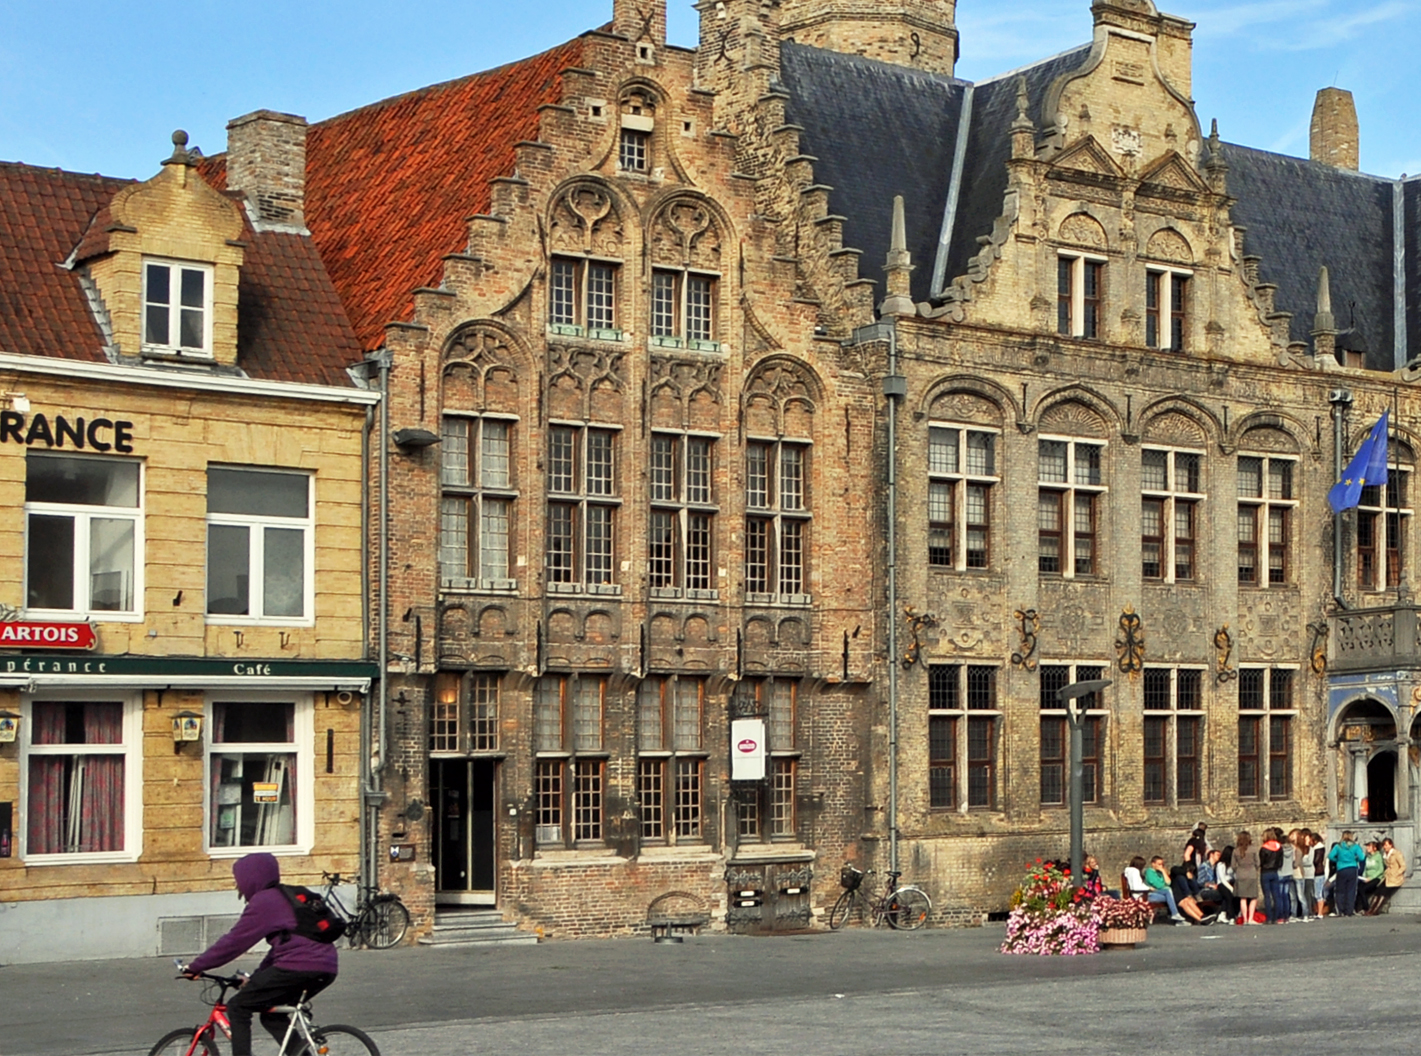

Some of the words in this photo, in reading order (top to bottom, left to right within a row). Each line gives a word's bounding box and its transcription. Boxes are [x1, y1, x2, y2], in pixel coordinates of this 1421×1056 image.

[0, 410, 133, 453] RANCE
[1, 626, 79, 642] ARTOIS
[233, 664, 271, 675] Café
